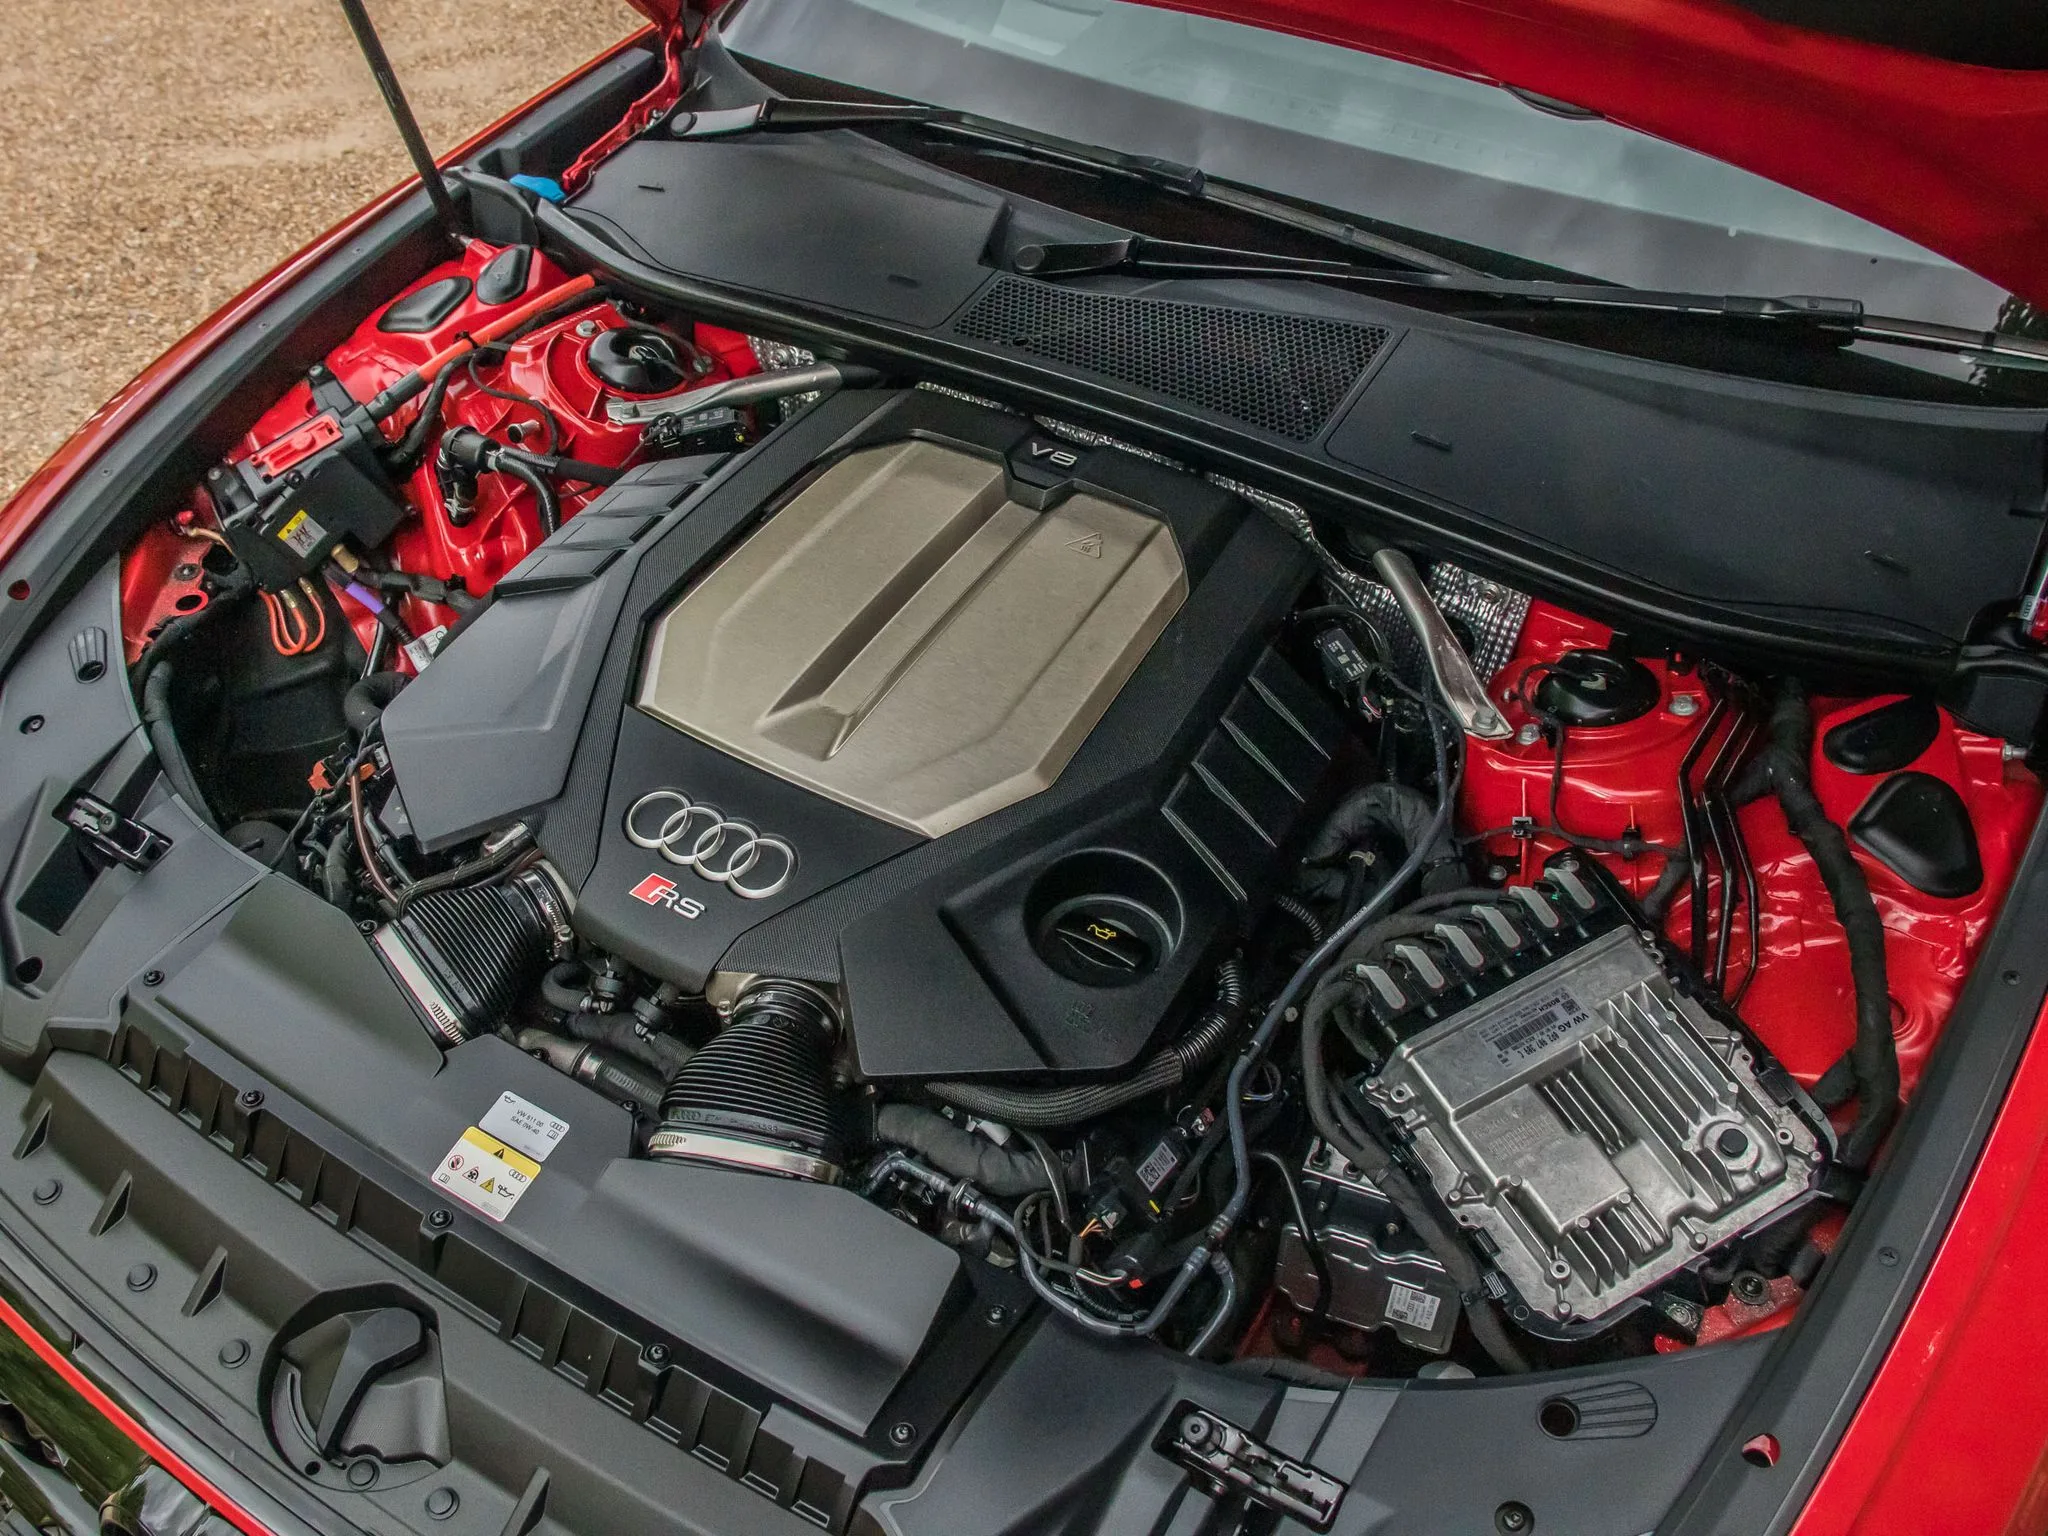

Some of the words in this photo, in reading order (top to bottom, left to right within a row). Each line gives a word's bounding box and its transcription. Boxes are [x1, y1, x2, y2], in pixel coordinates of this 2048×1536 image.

[1032, 442, 1077, 466] V8
[647, 885, 705, 919] RS
[1539, 997, 1560, 1012] BOSCH
[1558, 1021, 1572, 1032] AG
[1573, 1012, 1589, 1025] VW
[510, 1115, 523, 1125] SAE
[522, 1122, 540, 1134] 0W-40
[516, 1109, 527, 1118] VW
[526, 1114, 537, 1123] 511
[535, 1120, 544, 1128] 00
